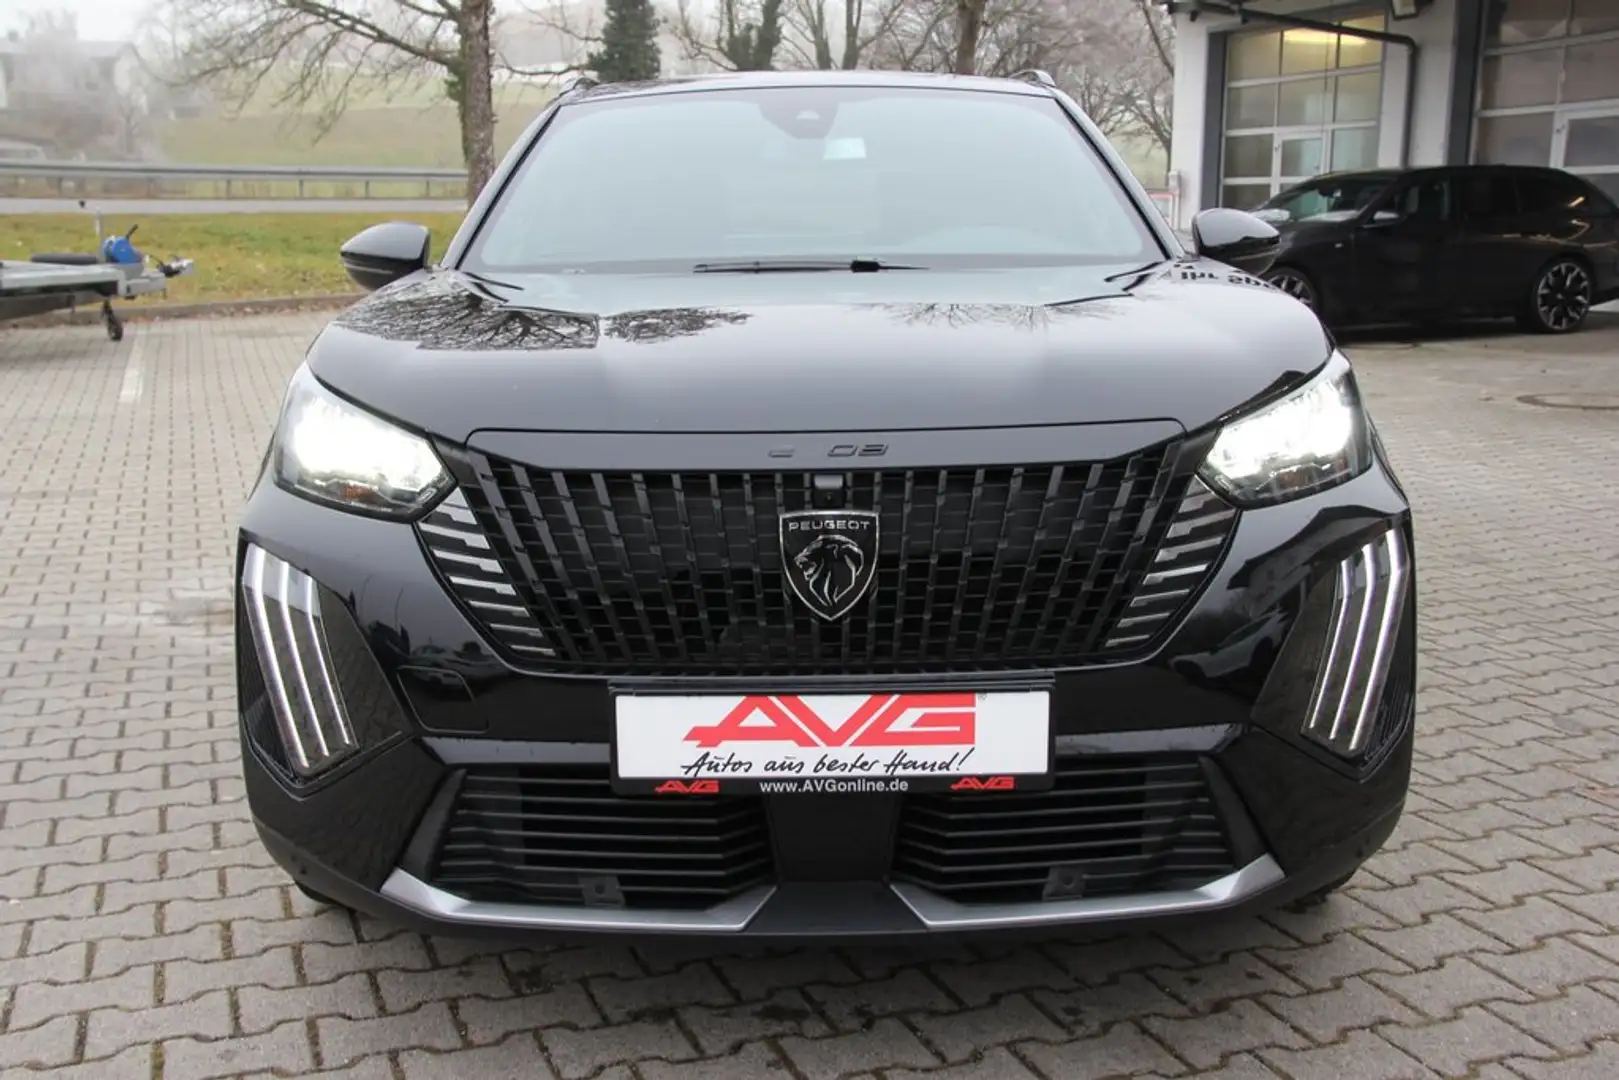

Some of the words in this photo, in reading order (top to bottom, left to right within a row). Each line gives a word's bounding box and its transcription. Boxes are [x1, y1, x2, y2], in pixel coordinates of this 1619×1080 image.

[788, 520, 870, 531] PEUGEOT
[683, 692, 976, 748] AVG
[812, 753, 880, 774] bester
[882, 747, 975, 776] Hand!
[654, 779, 719, 794] AVG
[759, 778, 909, 793] www.AVGonline.de
[949, 775, 1014, 790] AVG
